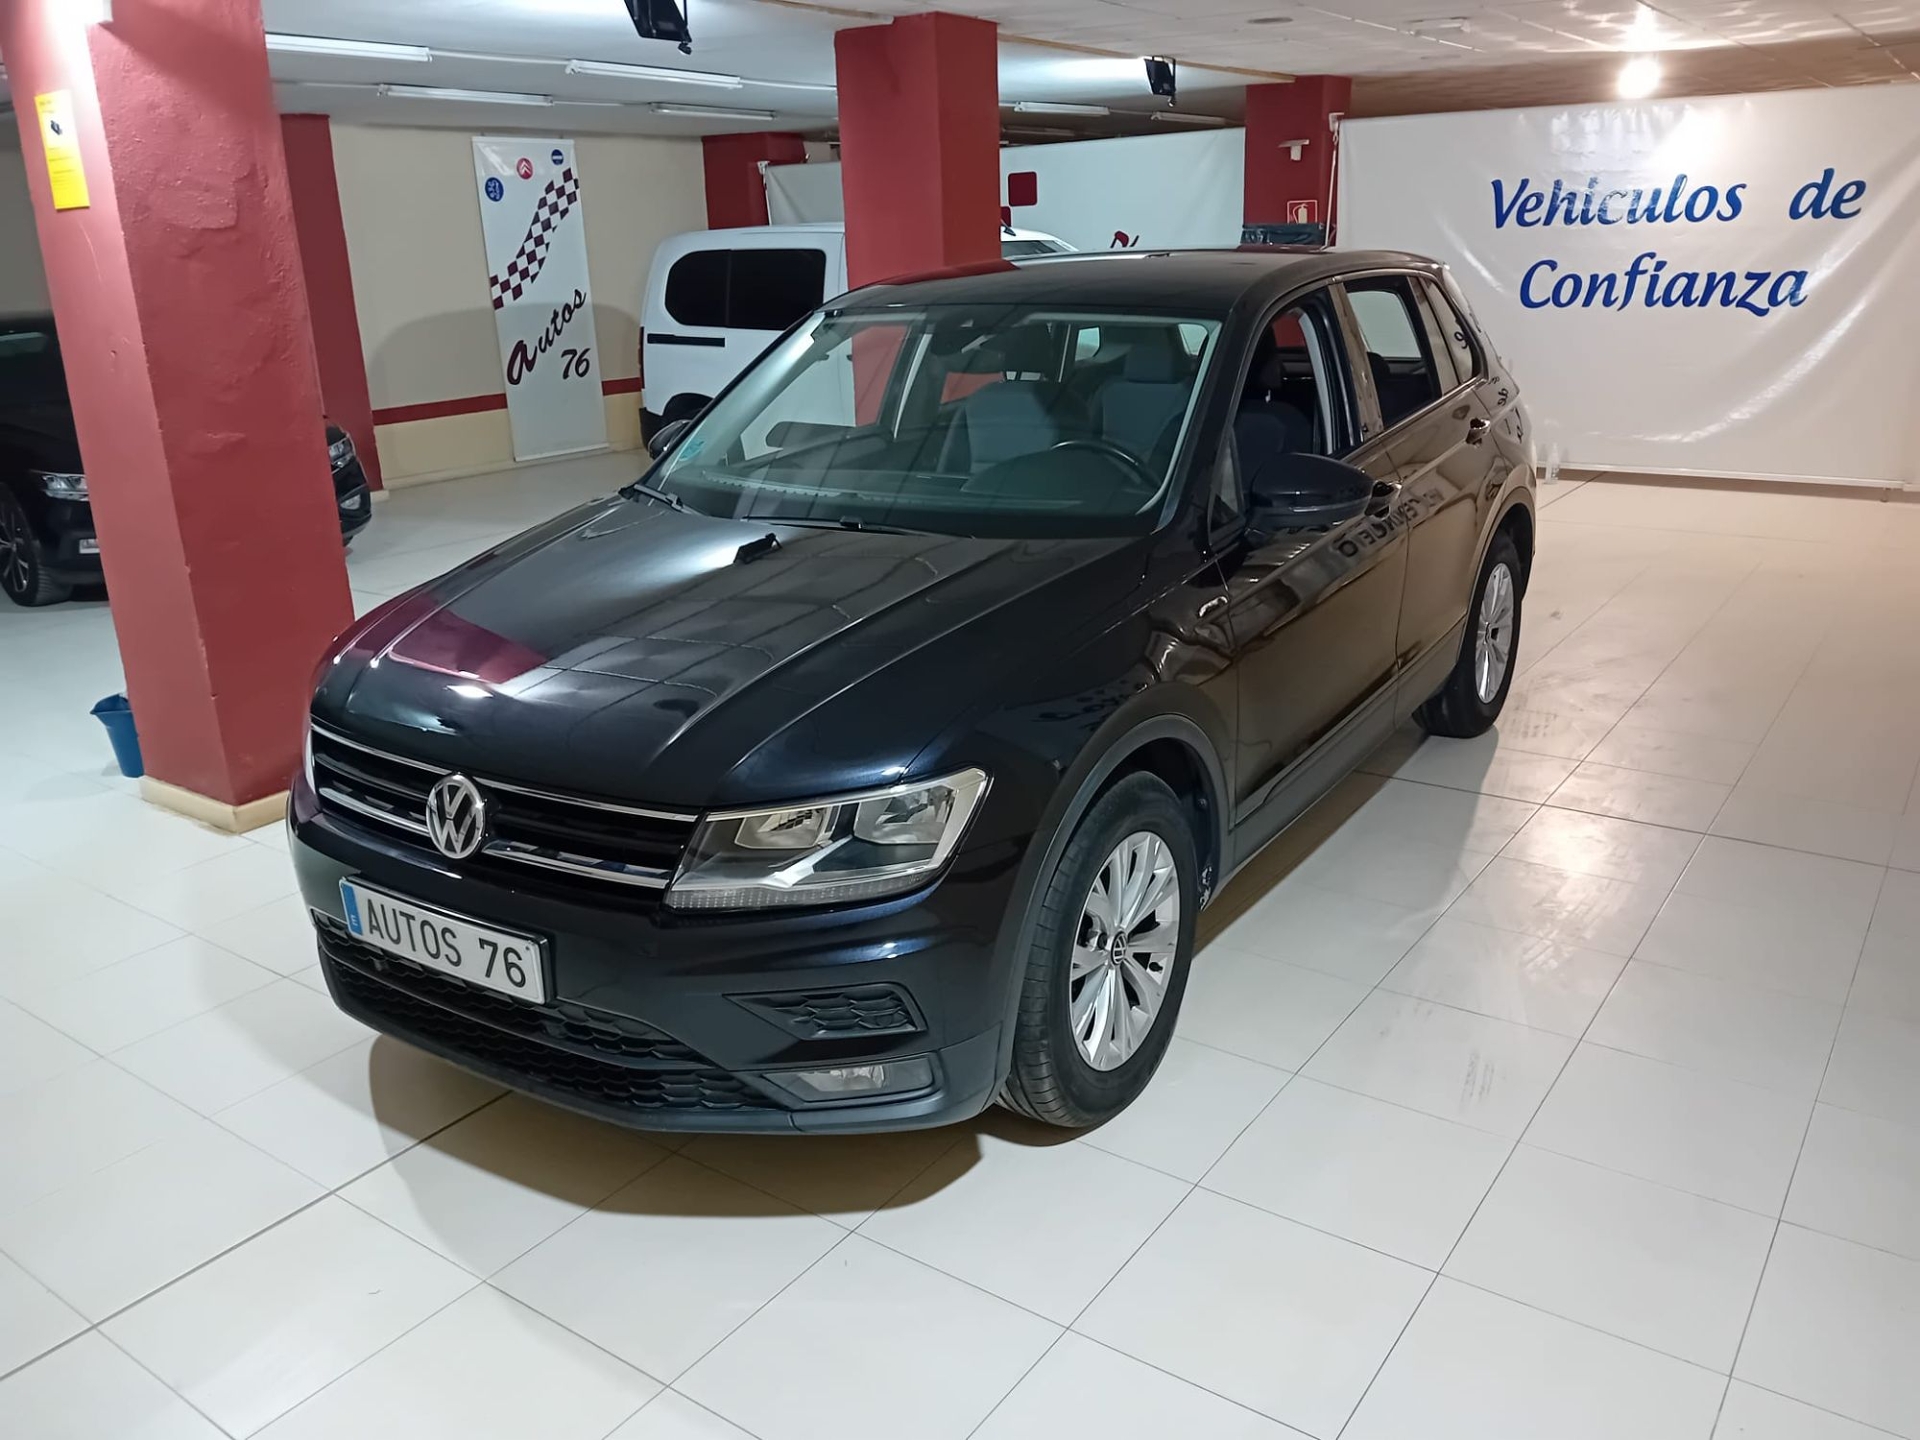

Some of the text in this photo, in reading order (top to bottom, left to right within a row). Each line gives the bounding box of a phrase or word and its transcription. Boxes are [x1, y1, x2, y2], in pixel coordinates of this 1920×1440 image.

[1788, 167, 1867, 221] de
[1519, 251, 1809, 318] Confianza
[560, 347, 591, 380] 76
[367, 898, 462, 967] AUTOS
[478, 937, 526, 988] 76
